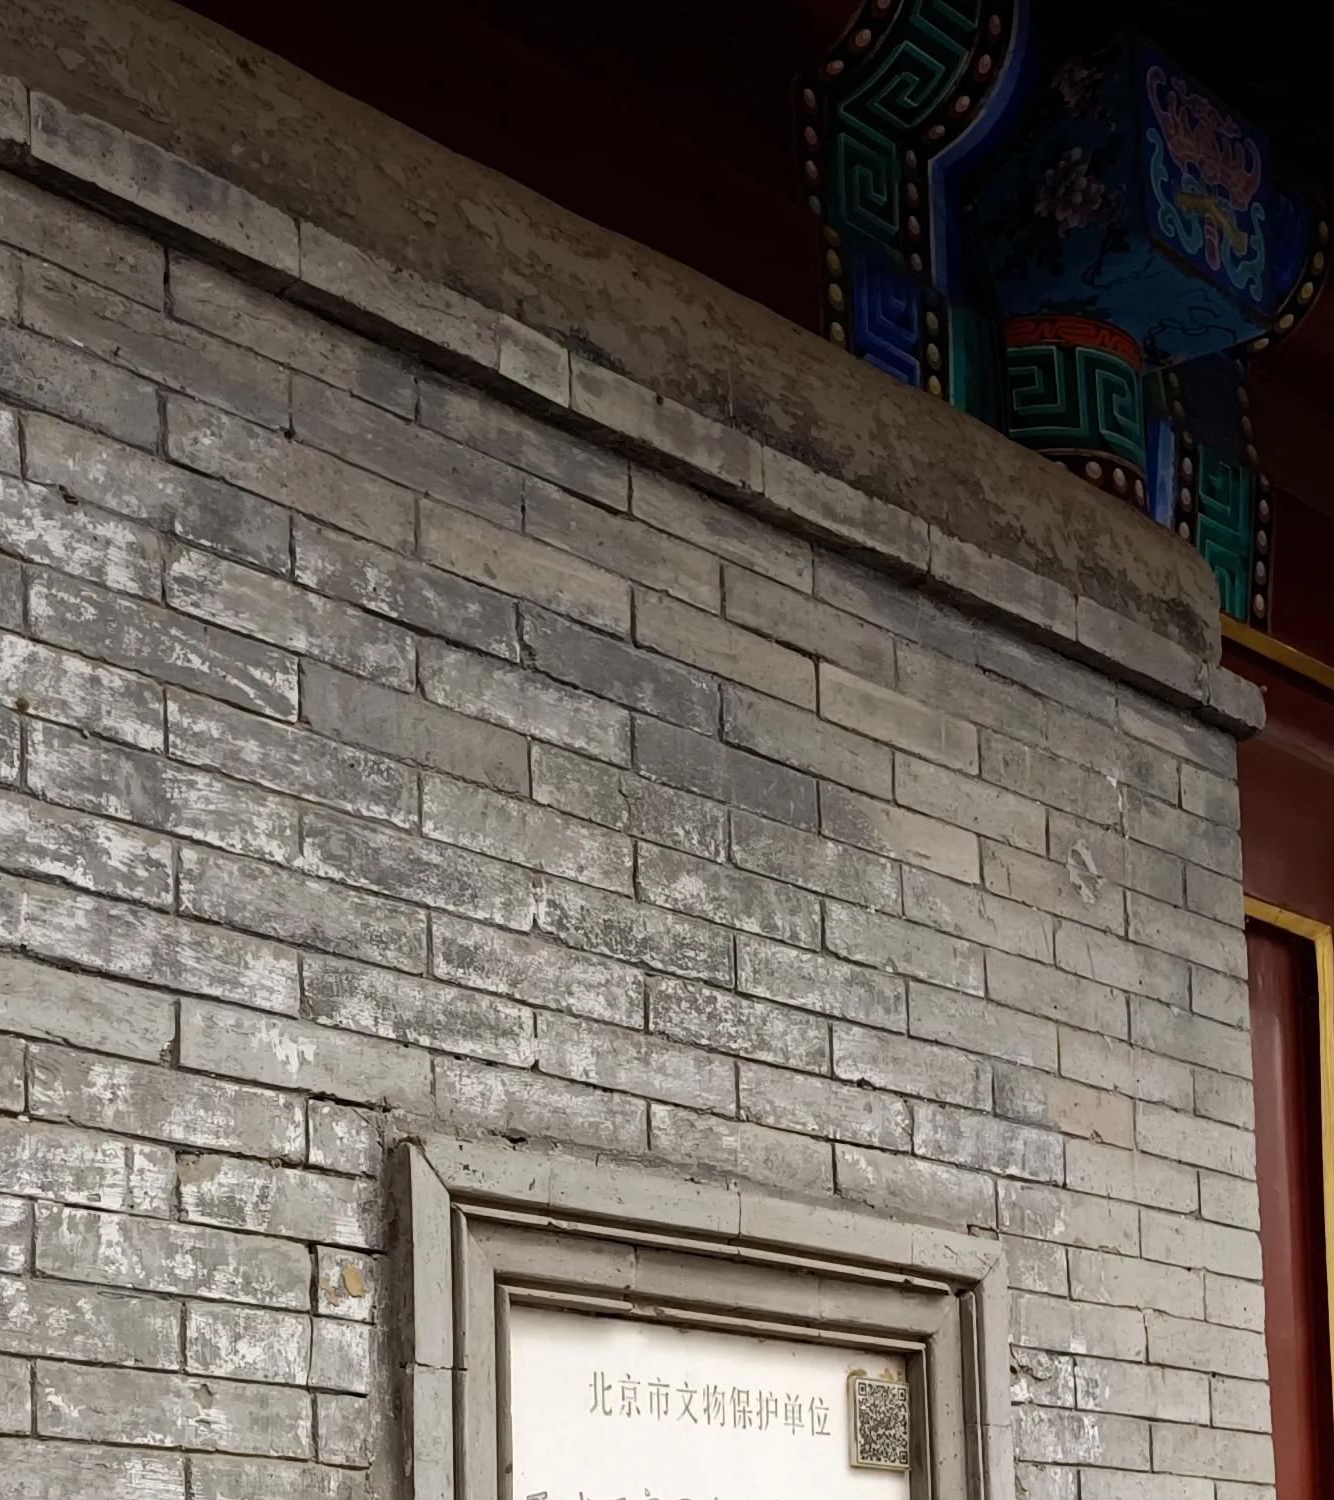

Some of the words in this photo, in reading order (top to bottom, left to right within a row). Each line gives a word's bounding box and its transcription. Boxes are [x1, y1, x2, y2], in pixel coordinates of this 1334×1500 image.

[588, 1371, 832, 1437] 北京市文物保护单位
